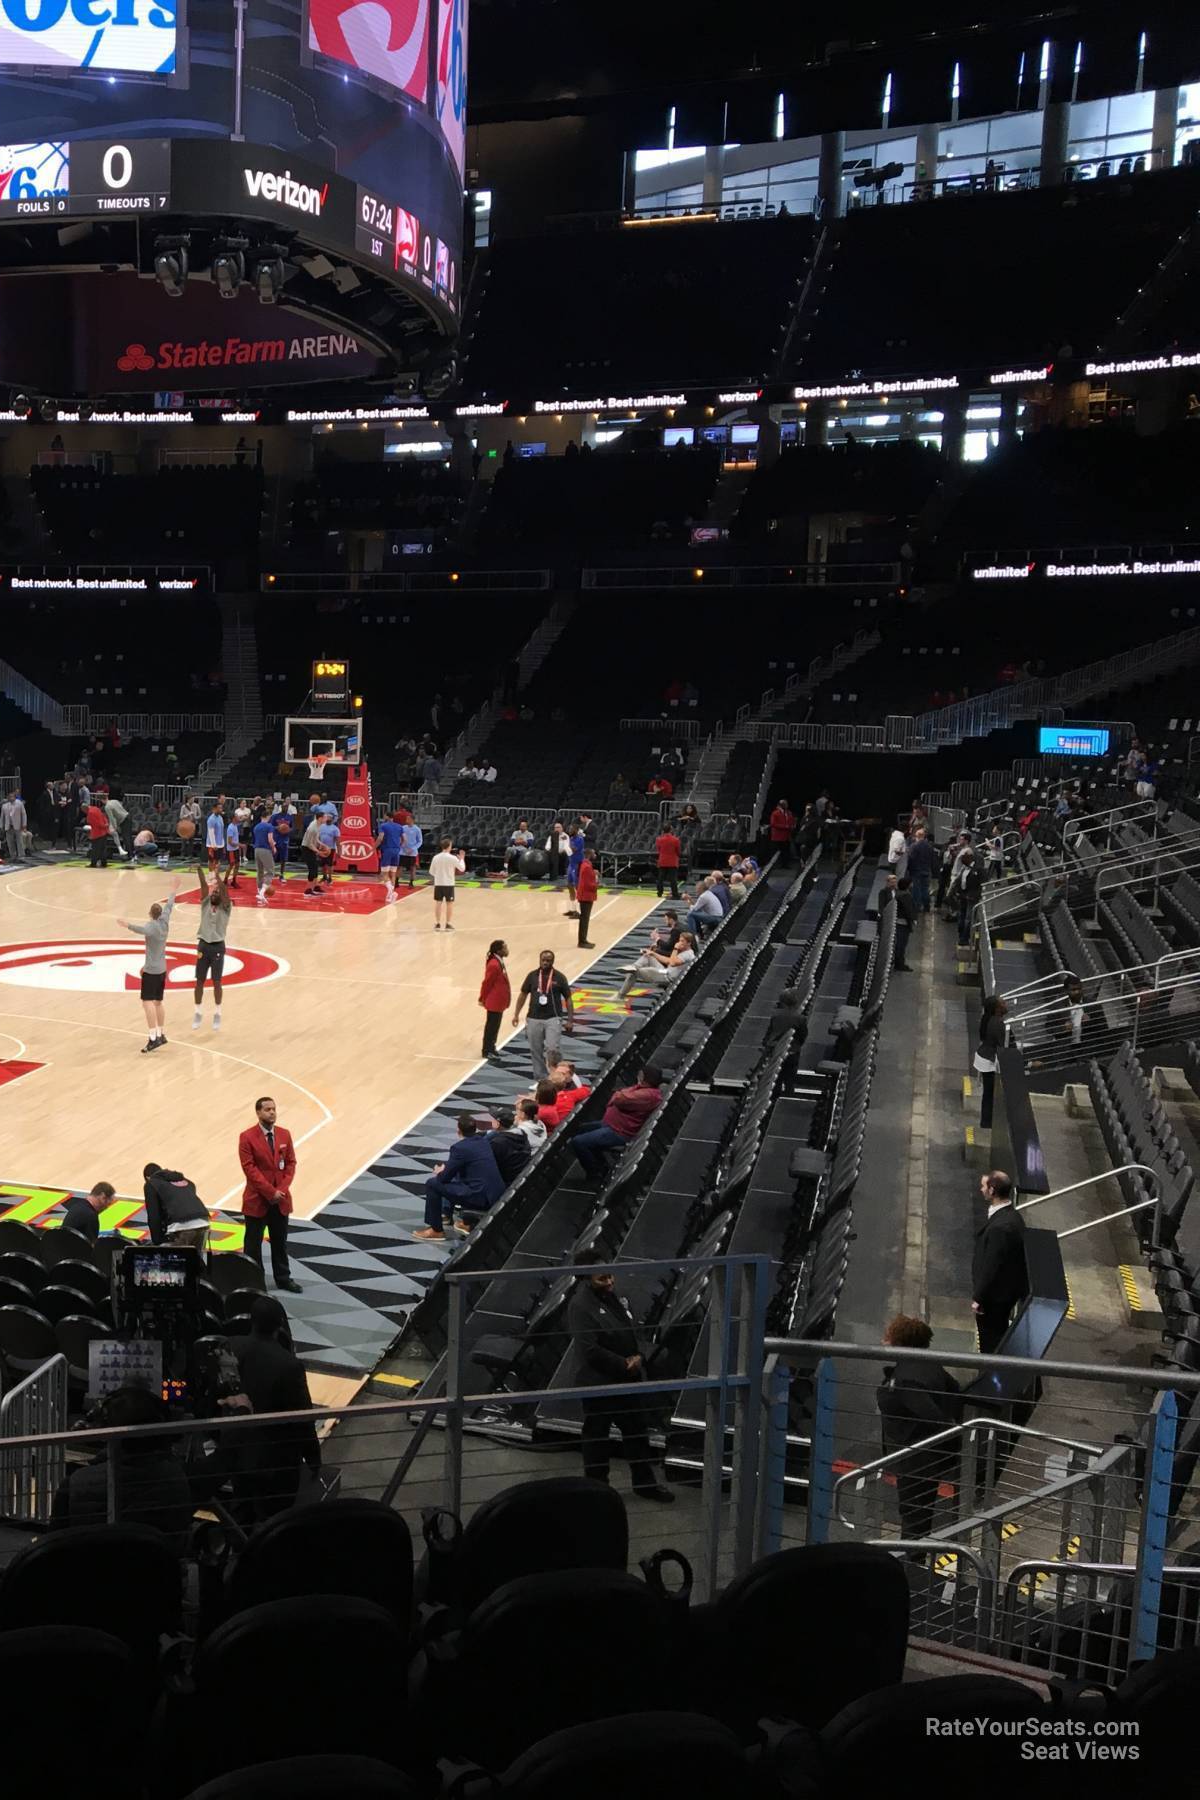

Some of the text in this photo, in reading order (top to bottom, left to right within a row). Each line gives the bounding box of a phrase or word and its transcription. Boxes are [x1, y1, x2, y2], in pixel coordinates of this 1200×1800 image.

[103, 145, 133, 189] 0
[244, 168, 321, 216] verizon
[17, 201, 65, 213] FOULS 0
[97, 197, 166, 209] TIMEOUTS 7
[362, 194, 393, 235] 67:24
[371, 238, 383, 257] 1ST
[288, 334, 359, 359] ARENA
[1086, 362, 1115, 375] Best
[1116, 357, 1171, 372] network.
[991, 368, 1047, 383] unlimited
[794, 376, 959, 398] Best network. Best unlimited.
[535, 394, 687, 411] Best network. Best unlimited.
[719, 392, 758, 402] verizon
[288, 407, 429, 421] Best network. Best unlimited.
[456, 403, 503, 415] unlimited
[57, 411, 79, 421] Best
[123, 412, 146, 422] Best
[146, 412, 193, 422] unlimited.
[222, 412, 255, 421] verizon
[974, 566, 1029, 578] unlimited
[1047, 565, 1075, 576] Best
[1076, 563, 1132, 575] network.
[1133, 562, 1161, 573] Best
[12, 578, 147, 588] Best network. Best unlimited.
[160, 580, 193, 588] verizon
[341, 845, 367, 857] KIA
